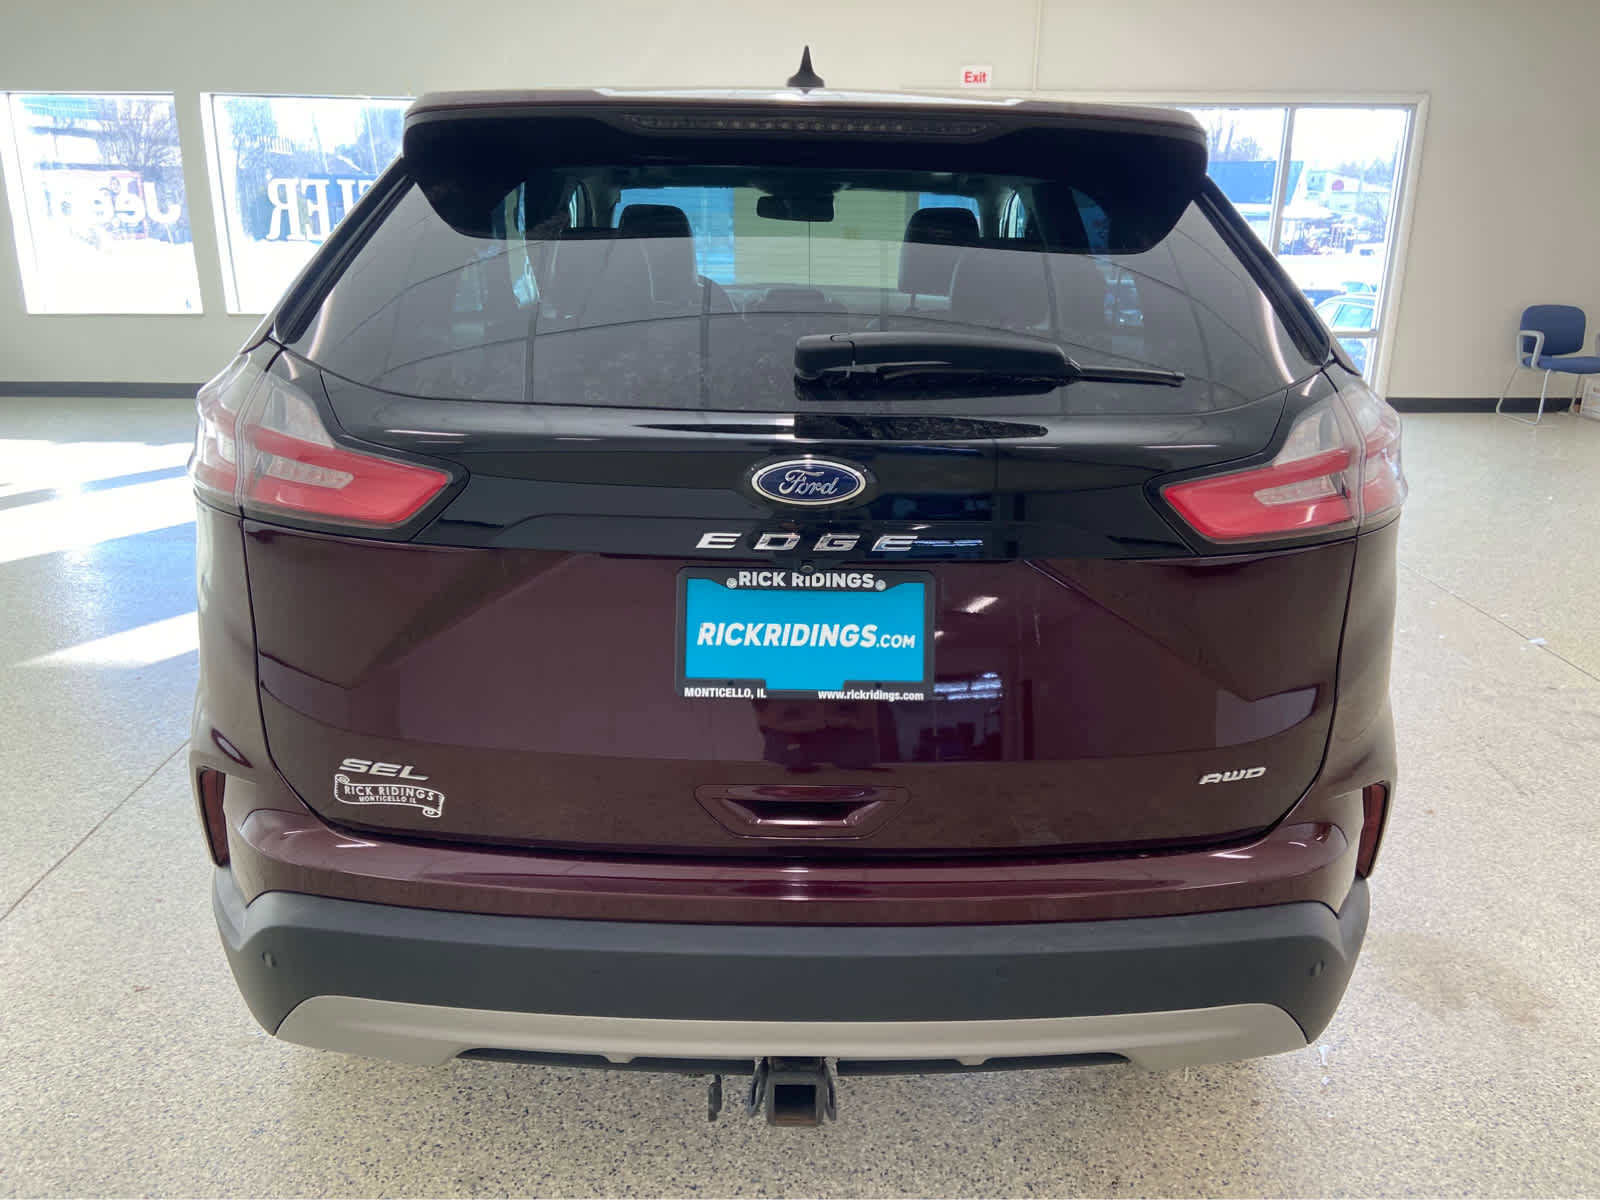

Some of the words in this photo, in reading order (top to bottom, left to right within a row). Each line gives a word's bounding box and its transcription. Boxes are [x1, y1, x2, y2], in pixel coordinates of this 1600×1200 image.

[964, 71, 987, 84] Exit
[779, 469, 839, 496] Ford
[696, 533, 918, 551] EDGE
[738, 571, 786, 588] RICK
[791, 572, 875, 589] RIDINGS
[697, 622, 916, 649] RICKRIDINGS.COM
[684, 687, 755, 700] MONTICELLO,
[756, 688, 767, 698] IL
[818, 690, 924, 702] www.rickridings.com
[339, 758, 429, 780] SEL
[1199, 767, 1266, 784] AWD
[344, 785, 373, 796] RICK
[378, 785, 435, 801] RIDINGS
[358, 795, 406, 803] MONTICELLO
